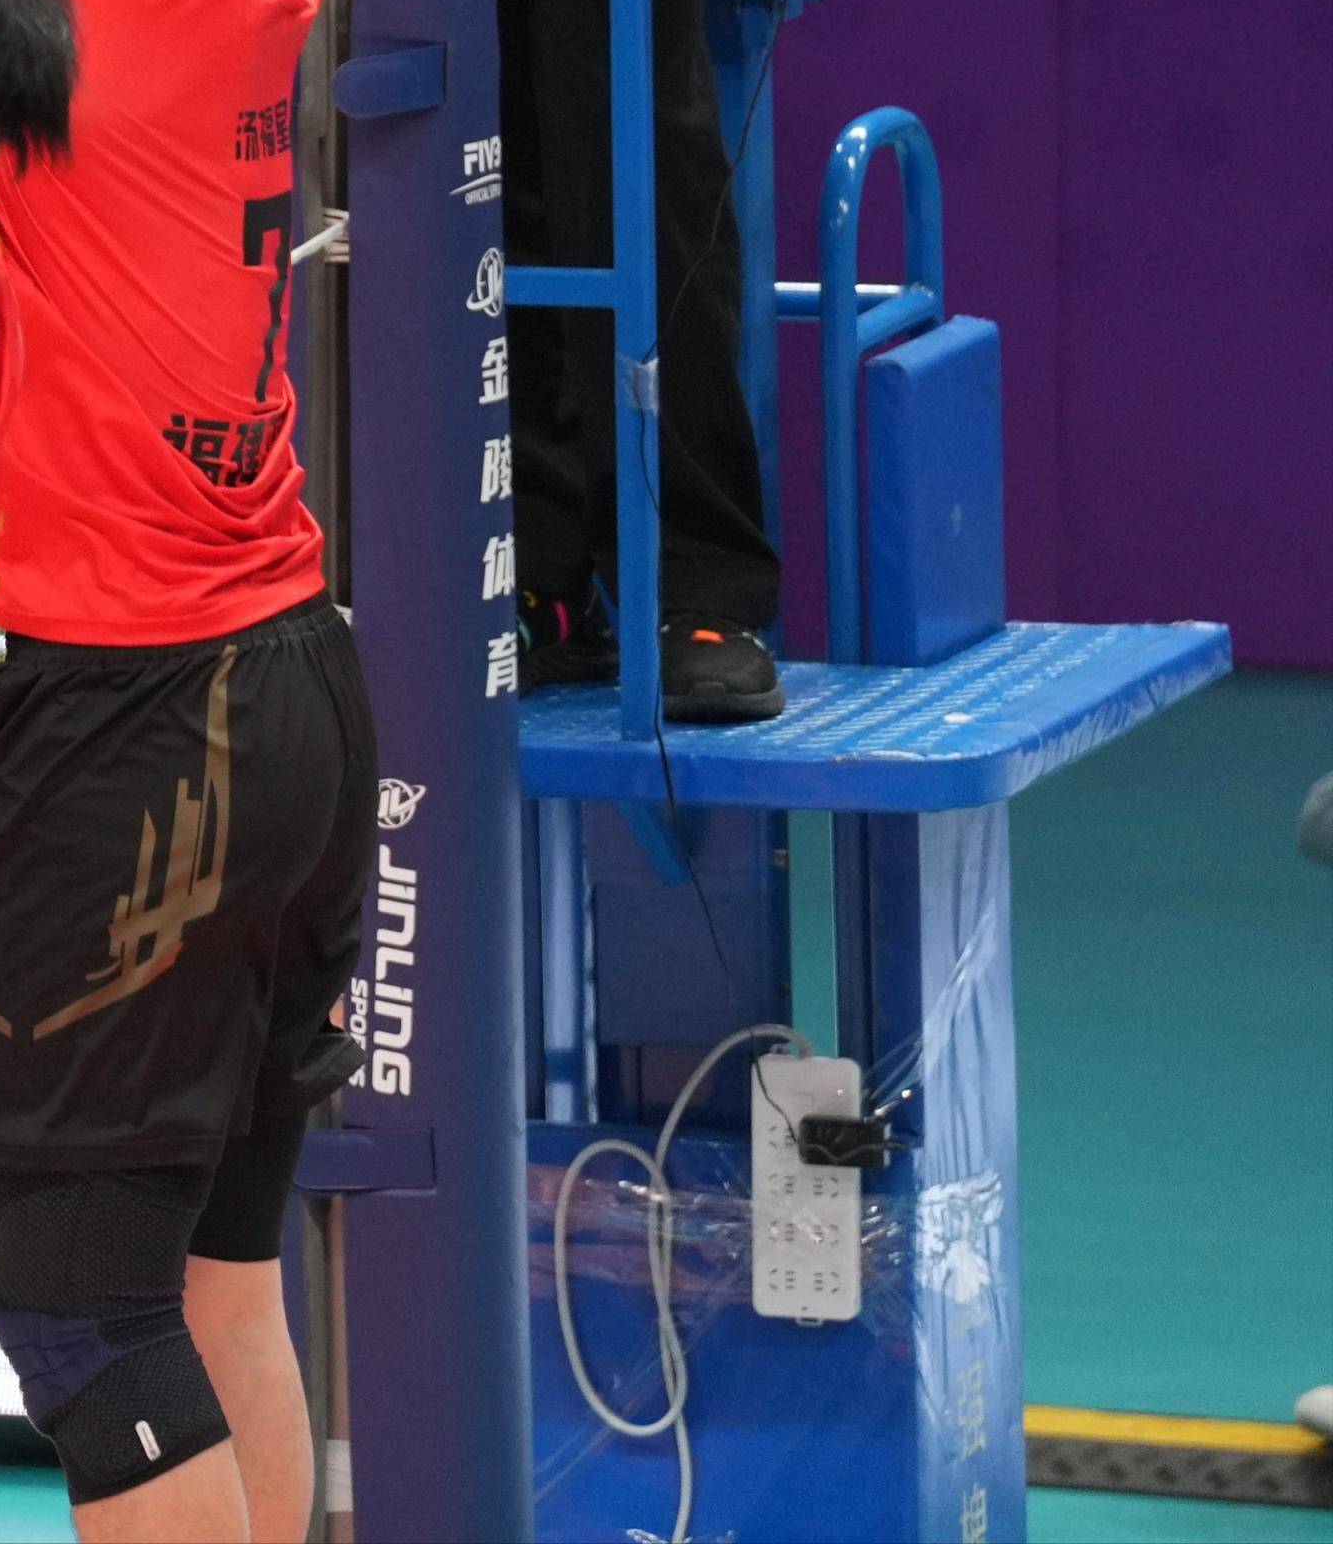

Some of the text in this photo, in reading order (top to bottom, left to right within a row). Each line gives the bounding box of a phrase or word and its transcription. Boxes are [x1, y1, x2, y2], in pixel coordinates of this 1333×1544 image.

[479, 335, 519, 698] 金陵体育
[348, 976, 369, 1088] SPOS
[371, 843, 418, 1097] JINLING
